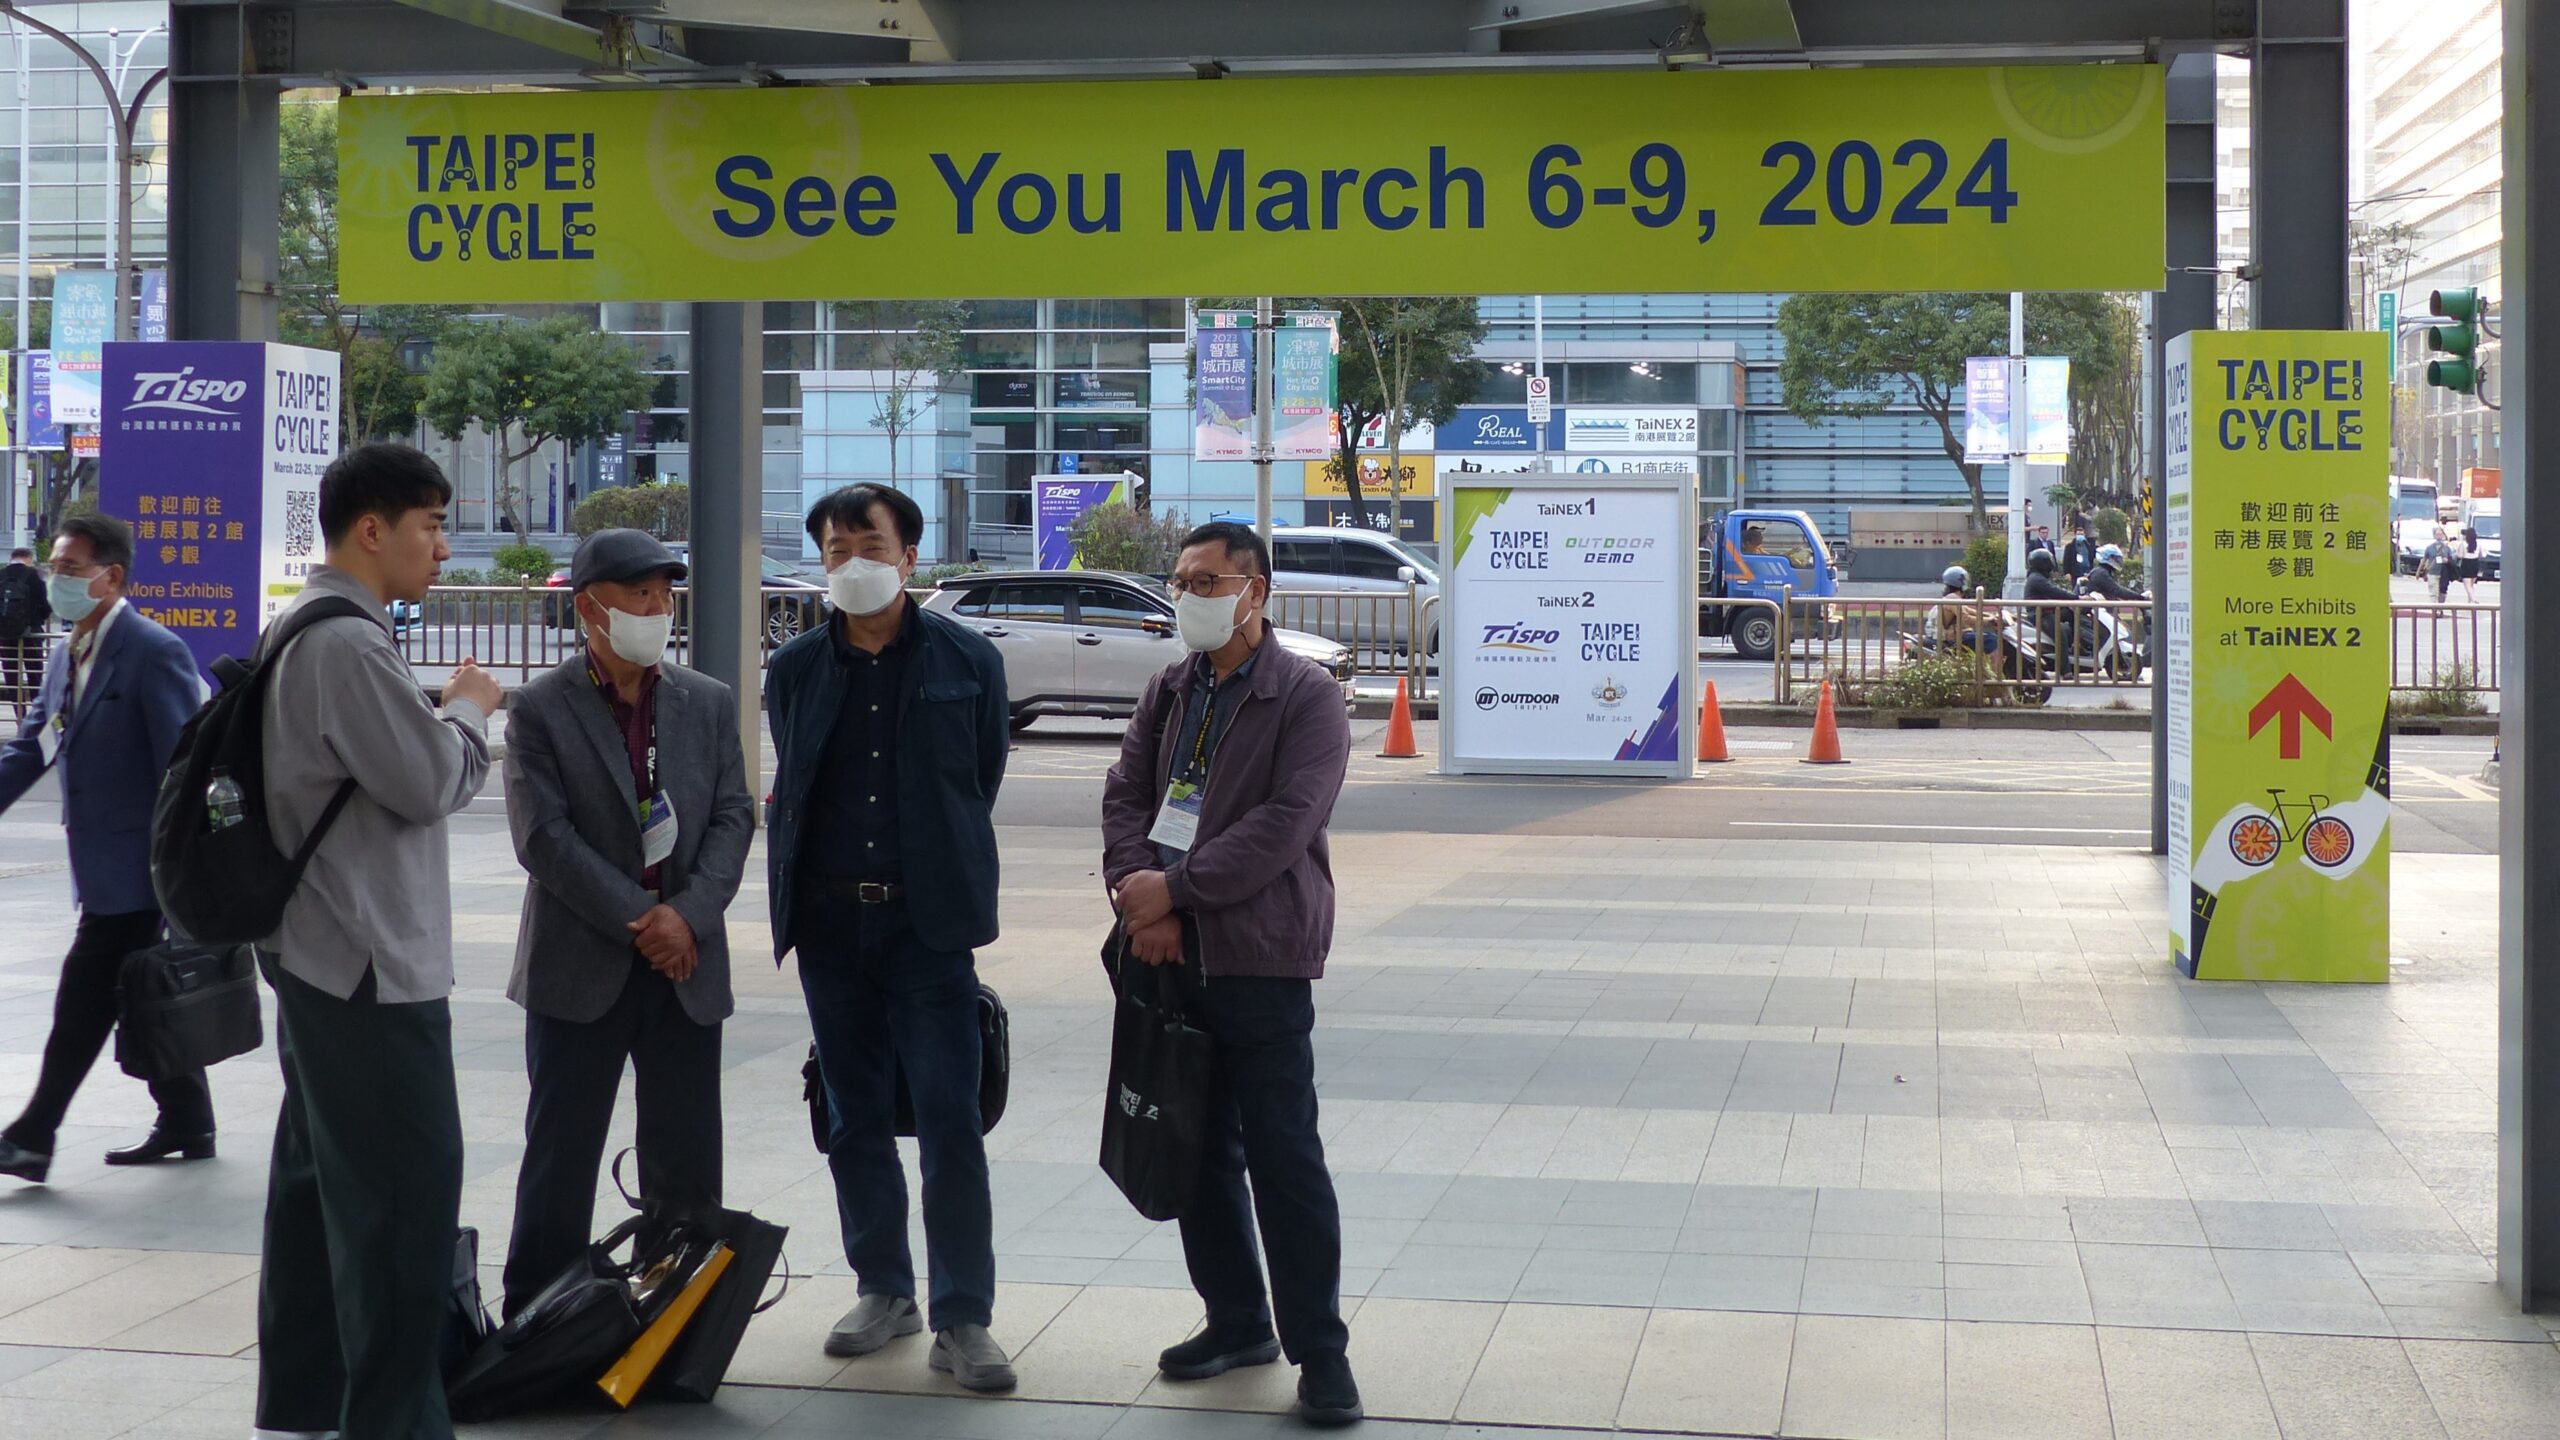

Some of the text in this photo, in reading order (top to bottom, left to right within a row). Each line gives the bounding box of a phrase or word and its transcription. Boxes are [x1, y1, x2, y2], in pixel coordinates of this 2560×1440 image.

[405, 132, 596, 193] TAIPEI
[711, 136, 2018, 245] See You March 6-9, 2024
[408, 202, 596, 262] CYCLE
[1212, 333, 1238, 342] 2023
[1209, 343, 1239, 358] 智慧
[1202, 358, 1246, 374] 城市展
[1281, 355, 1324, 370] 城市展
[2217, 359, 2362, 401] TAIPEI
[276, 369, 331, 412] TAIPEI
[1635, 418, 1696, 430] TaiNEX 2
[2218, 408, 2363, 451] CYCLE
[275, 414, 330, 455] CYCLE
[273, 461, 294, 473] March
[138, 495, 222, 516] 歡迎前往
[1537, 498, 1596, 516] TaiNEX 1
[2240, 502, 2340, 523] 歡迎前往
[1490, 531, 1656, 549] TAIPEI OUTDOOR
[159, 545, 200, 565] 參觀
[1490, 551, 1635, 569] CYCLE DEMO
[2266, 556, 2314, 578] 參觀
[127, 582, 233, 599] More Exhibits
[1537, 591, 1595, 608] TaiNEX 2
[2225, 596, 2357, 615] More Exhibits
[223, 609, 237, 628] 2
[1580, 623, 1640, 641] TAIPEI
[2219, 626, 2362, 647] at TaiNEX 2
[1580, 643, 1641, 662] CYCLE
[1501, 693, 1560, 705] OUTDOOR
